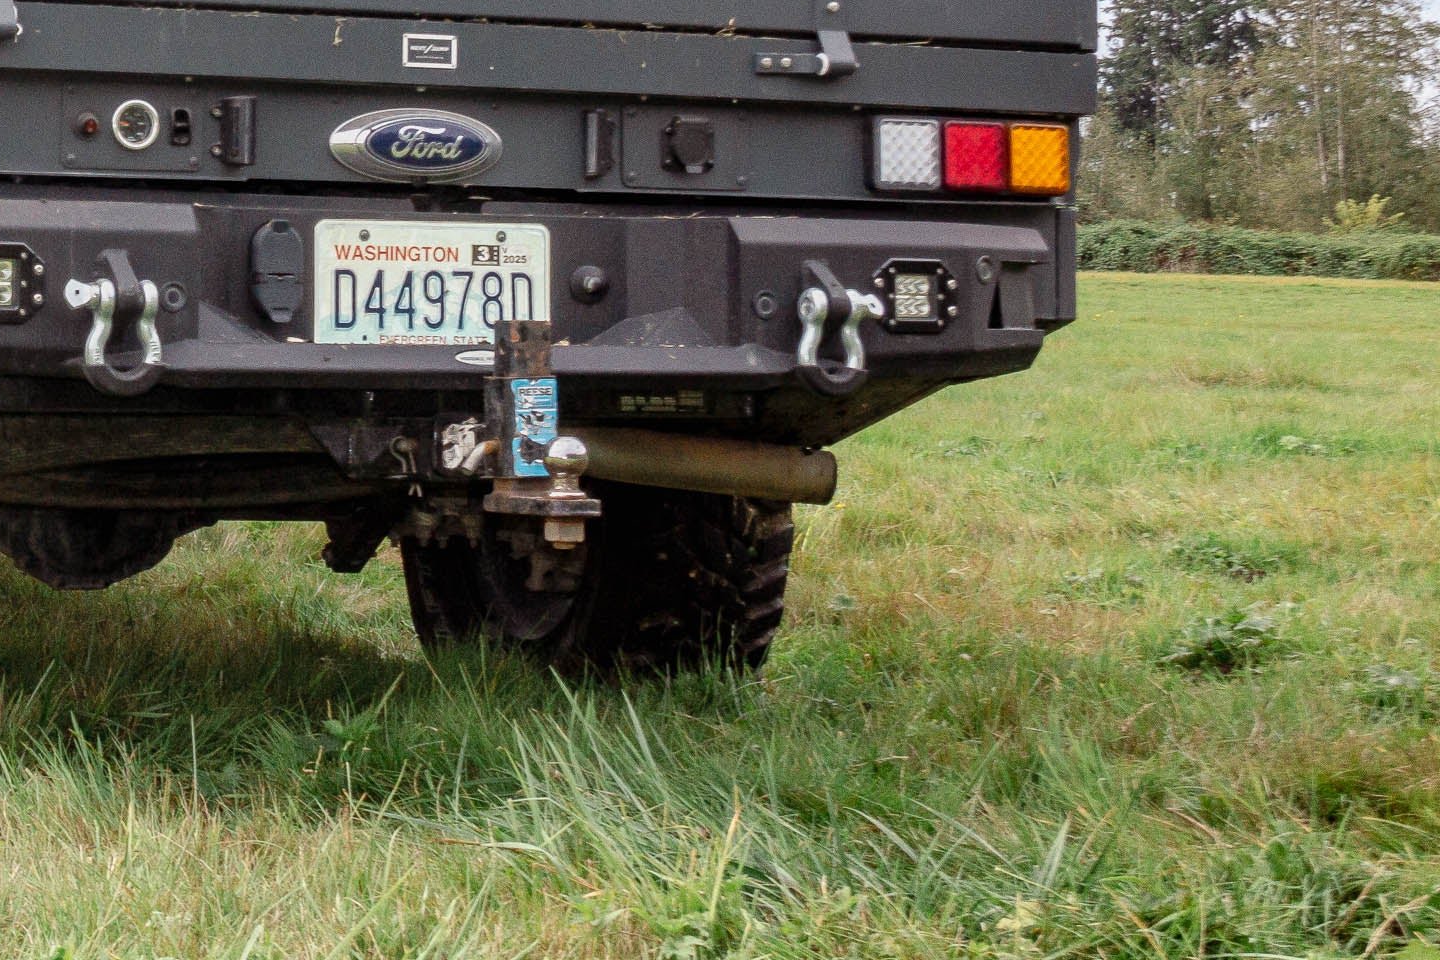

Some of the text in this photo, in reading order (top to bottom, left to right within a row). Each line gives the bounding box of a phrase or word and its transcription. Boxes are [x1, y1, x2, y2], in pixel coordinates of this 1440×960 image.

[390, 125, 464, 160] Ford
[334, 244, 459, 262] WASHINGTON
[477, 246, 490, 261] 3
[503, 255, 527, 264] 2025
[334, 269, 534, 330] D44978D
